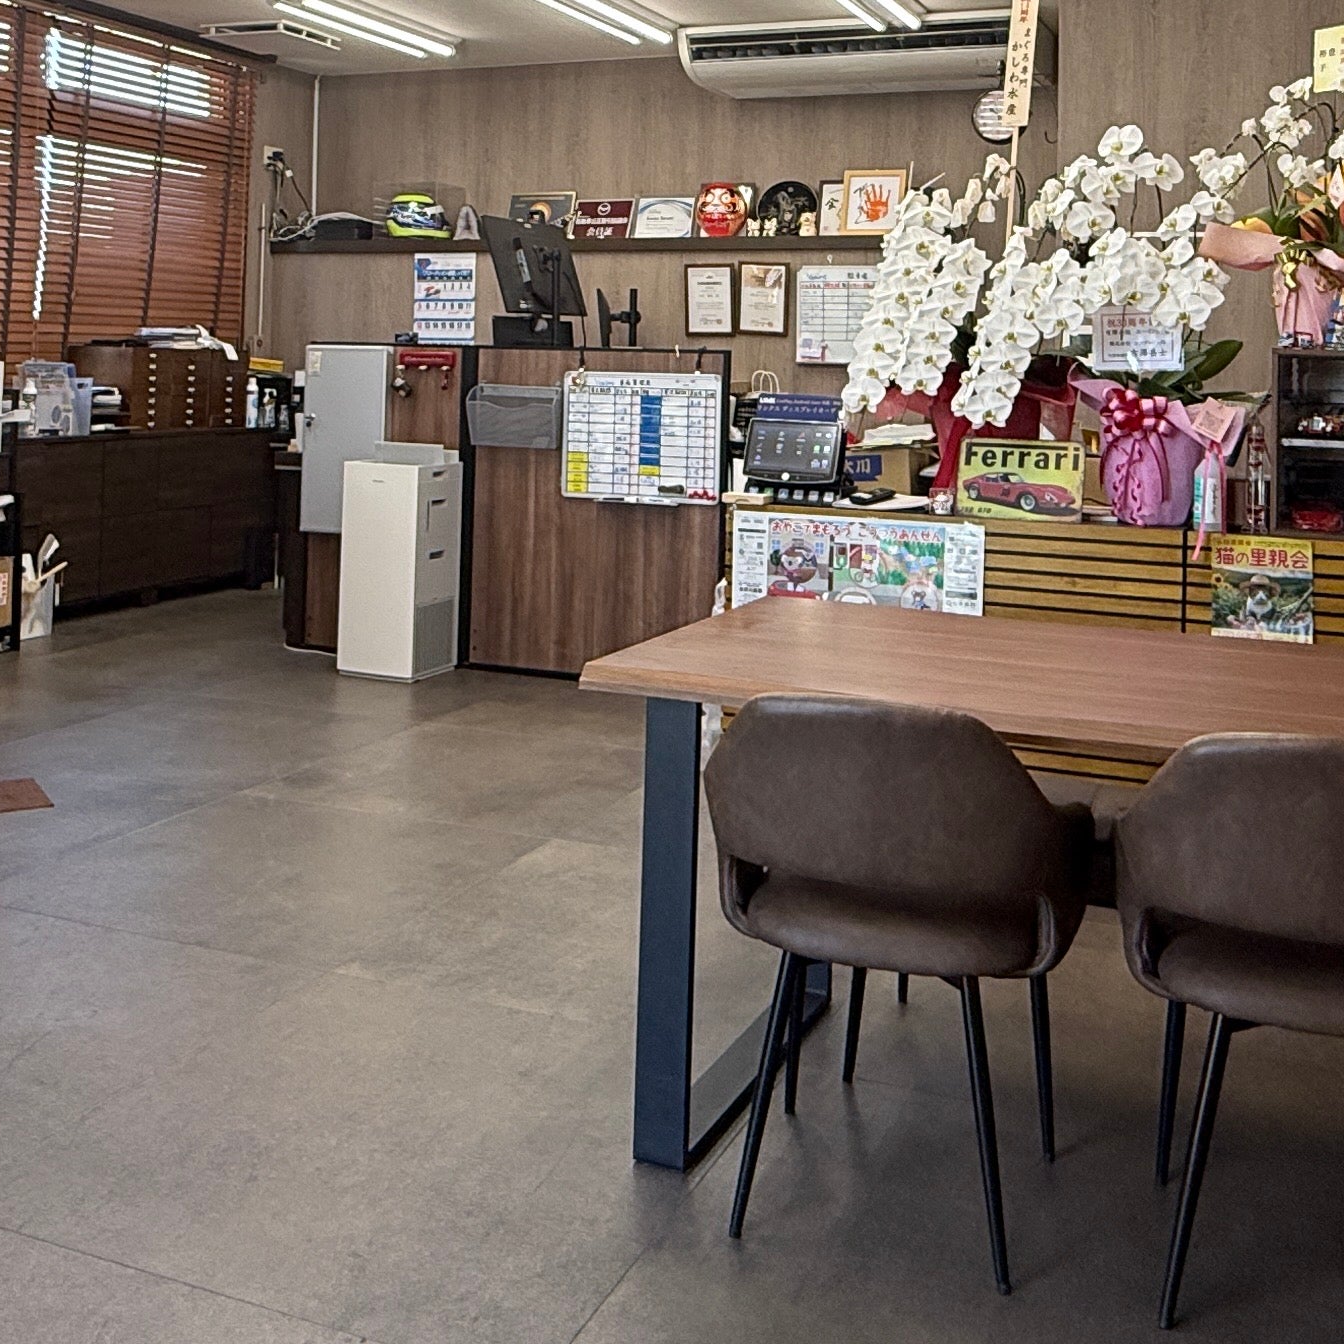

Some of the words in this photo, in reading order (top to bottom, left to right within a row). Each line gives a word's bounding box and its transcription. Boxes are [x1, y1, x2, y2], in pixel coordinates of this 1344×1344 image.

[1006, 41, 1023, 115] かしわ水産
[1019, 27, 1032, 88] まぐろ専門
[964, 442, 1081, 471] Ferrari
[1216, 547, 1309, 569] 猫の里親会
